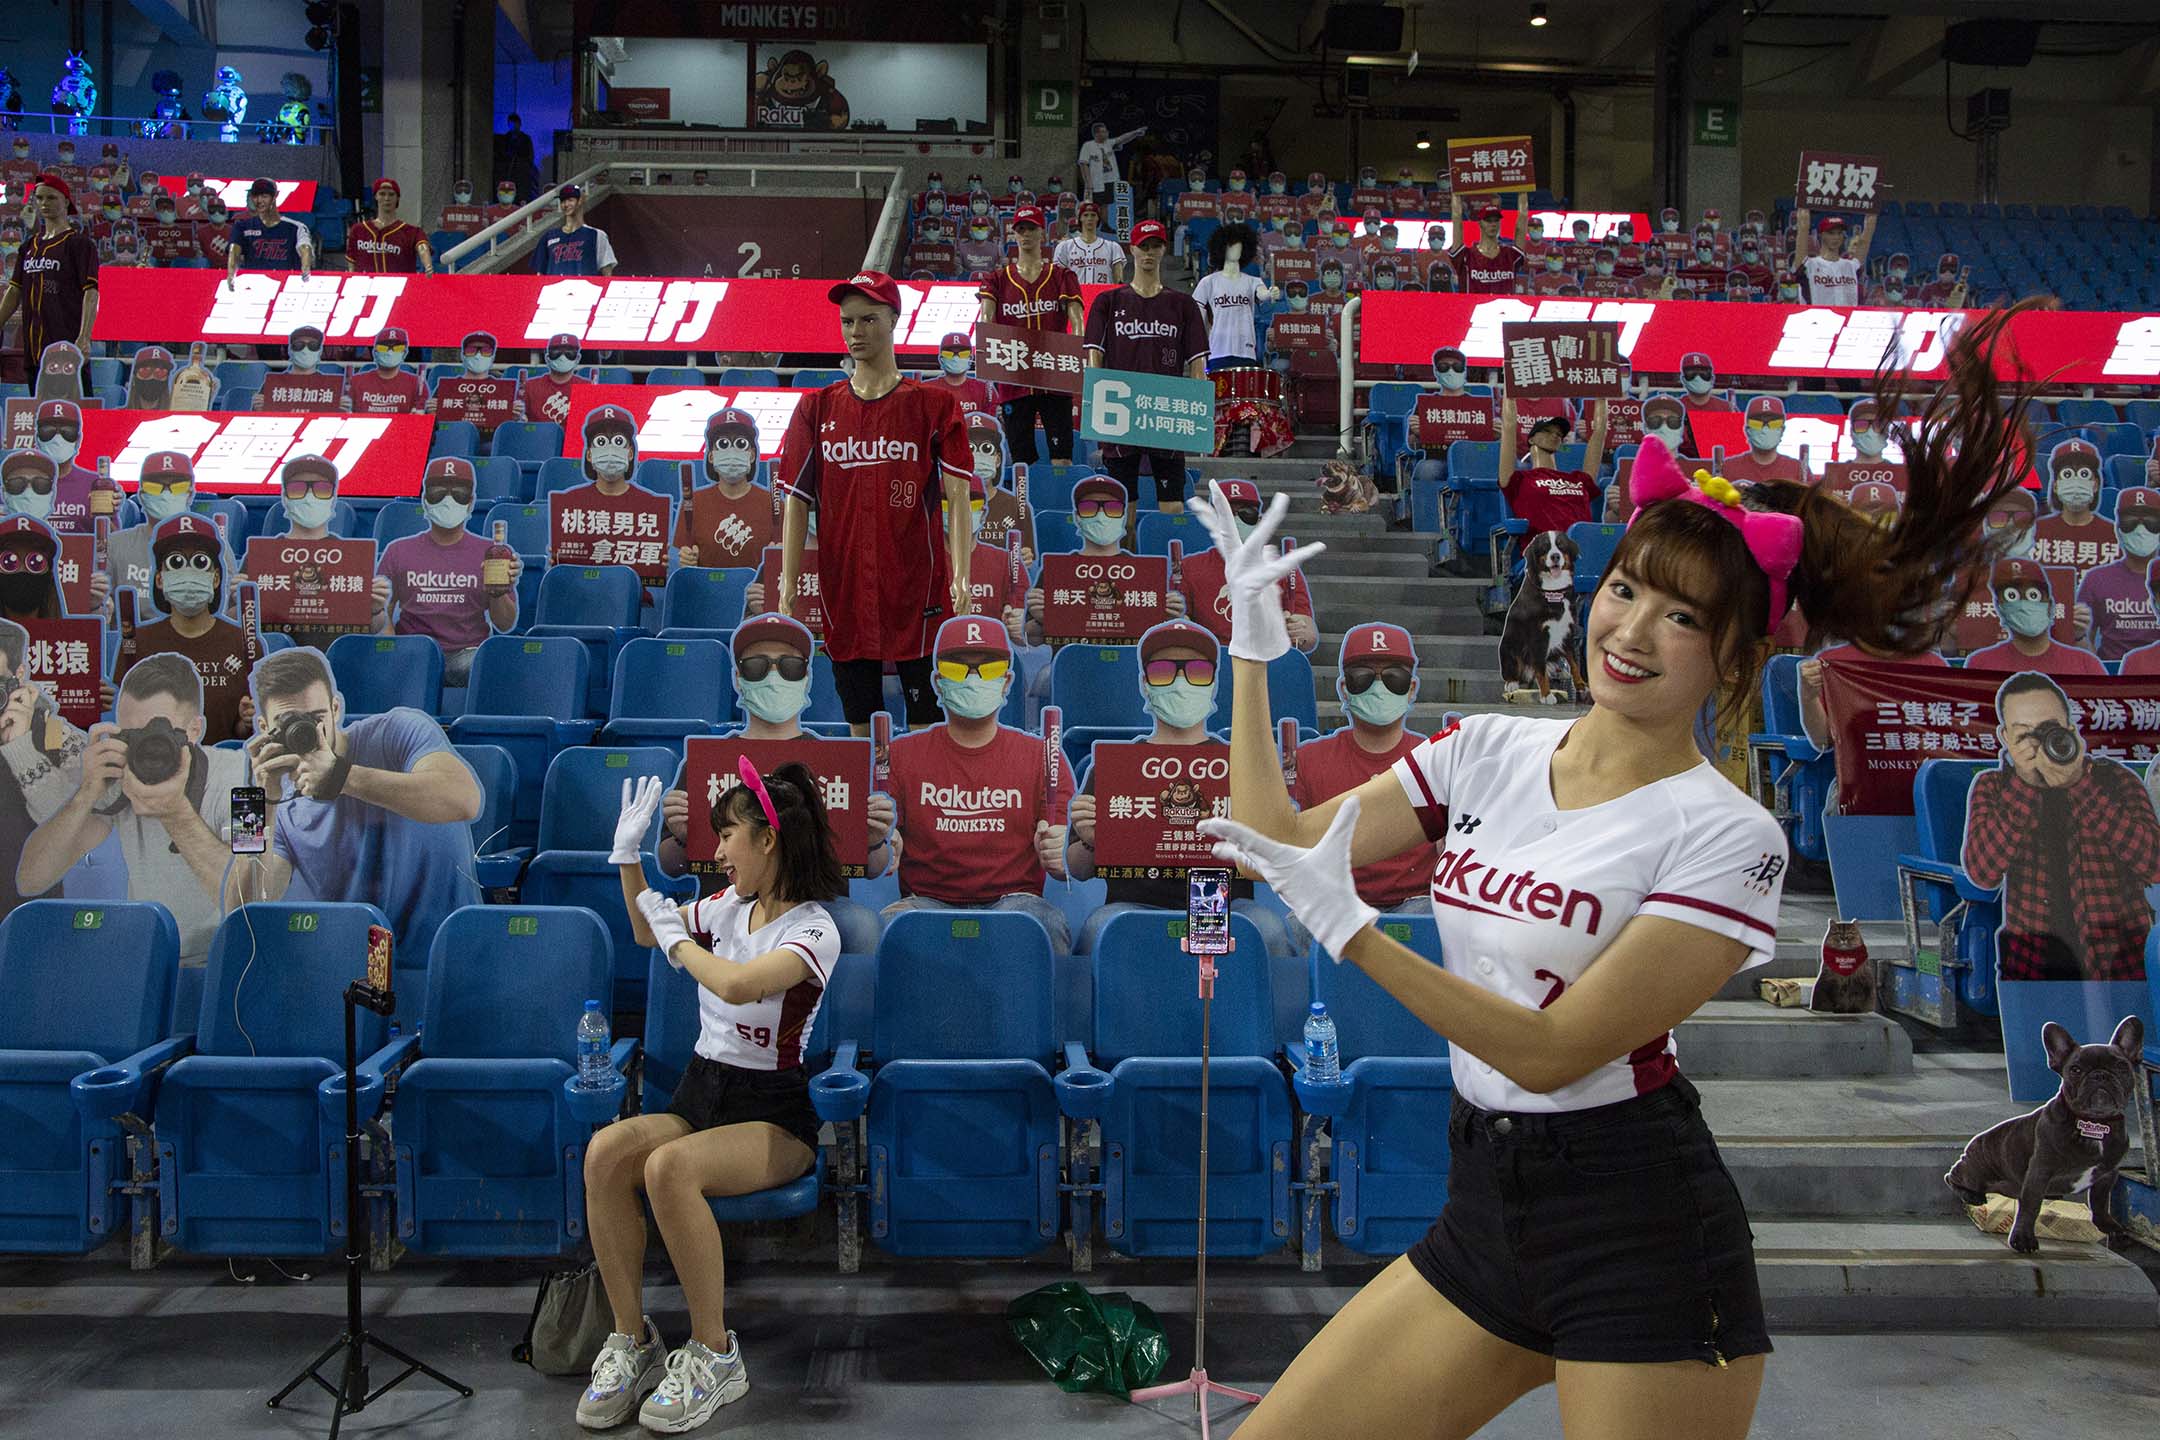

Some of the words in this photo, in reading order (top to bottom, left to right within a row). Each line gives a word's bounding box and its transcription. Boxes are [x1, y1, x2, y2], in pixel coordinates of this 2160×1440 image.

[720, 4, 816, 28] MONKEYS
[1040, 89, 1059, 110] D
[758, 106, 806, 123] Rakut
[1708, 108, 1724, 130] E
[1455, 149, 1527, 168] 一棒得分
[1806, 161, 1878, 199] 奴奴
[1116, 181, 1129, 241] 我一直都在
[357, 239, 401, 255] Rakuten
[738, 242, 761, 278] 2
[1276, 259, 1312, 269] 桃猿加油
[1471, 268, 1515, 281] Rakuten
[1814, 275, 1857, 286] Rakuten
[202, 273, 408, 337] 全壘打
[524, 278, 731, 344] 全壘打
[1002, 299, 1059, 316] Rakuten
[1115, 319, 1177, 338] Rakuten
[1279, 323, 1321, 335] 桃猿加油
[953, 335, 961, 344] R
[152, 349, 160, 358] R
[985, 335, 1029, 371] 球
[1693, 356, 1700, 365] R
[1566, 368, 1617, 385] 林泓育
[272, 387, 334, 403] 桃猿加油
[458, 384, 477, 393] GO
[478, 384, 496, 393] GO
[363, 392, 406, 403] Rakuten
[443, 399, 463, 409] 樂天
[487, 399, 509, 410] 桃猿
[1135, 394, 1208, 416] 你是我的
[1762, 399, 1770, 409] R
[53, 404, 63, 415] R
[604, 408, 615, 418] R
[726, 410, 736, 421] R
[1091, 378, 1131, 437] 6
[1622, 405, 1639, 414] GO
[636, 390, 803, 455] 全壘
[971, 416, 982, 426] R
[1426, 408, 1486, 425] 桃猿加油
[821, 436, 919, 462] Rakuten
[2071, 442, 2080, 452] R
[162, 455, 173, 468] R
[444, 461, 455, 473] R
[1849, 470, 1870, 482] GO
[1872, 470, 1894, 482] GO
[889, 479, 917, 508] 29
[1230, 484, 1241, 494] R
[1869, 488, 1880, 500] R
[1018, 476, 1026, 519] Rakuten
[2135, 492, 2145, 505] R
[50, 502, 85, 517] uten
[17, 517, 31, 531] R
[178, 517, 194, 530] R
[561, 508, 660, 537] 桃猿男兒
[979, 531, 1005, 540] LDER
[281, 548, 309, 563] GO
[313, 549, 343, 563] GO
[589, 540, 664, 565] 拿冠軍
[407, 570, 477, 588] Rakuten
[1075, 564, 1103, 579] GO
[1107, 564, 1136, 580] GO
[257, 574, 291, 591] 樂天
[329, 575, 364, 593] 桃猿
[416, 594, 465, 604] MONKEYS
[1053, 589, 1086, 605] 樂天
[1123, 590, 1157, 608] 桃猿
[2106, 598, 2152, 614] Rakut
[1966, 602, 1996, 618] 樂天
[245, 599, 256, 660] Rakuten
[967, 623, 982, 642] R
[1372, 631, 1387, 648] R
[1875, 702, 1980, 726] 三隻猴子
[1865, 732, 1999, 751] 三重麥芽威士忌
[1050, 724, 1059, 787] Rakuten
[1141, 757, 1183, 779] GO
[1188, 758, 1229, 779] GO
[1868, 759, 1920, 770] MONKEY
[706, 774, 850, 811] 桃油
[920, 782, 1021, 809] Rakuten
[1109, 795, 1156, 820] 樂天
[1212, 796, 1232, 819] 桃
[1163, 807, 1200, 817] Rakuten
[936, 818, 1005, 833] MONKEYS
[1162, 830, 1206, 841] 三隻猴子
[691, 862, 725, 874] 禁止酒
[1096, 868, 1145, 879] 禁止酒駕
[1431, 847, 1603, 937] akuten
[83, 912, 95, 927] 9
[295, 914, 314, 930] 10
[736, 1023, 771, 1047] 59
[2078, 1121, 2110, 1133] Rakuten
